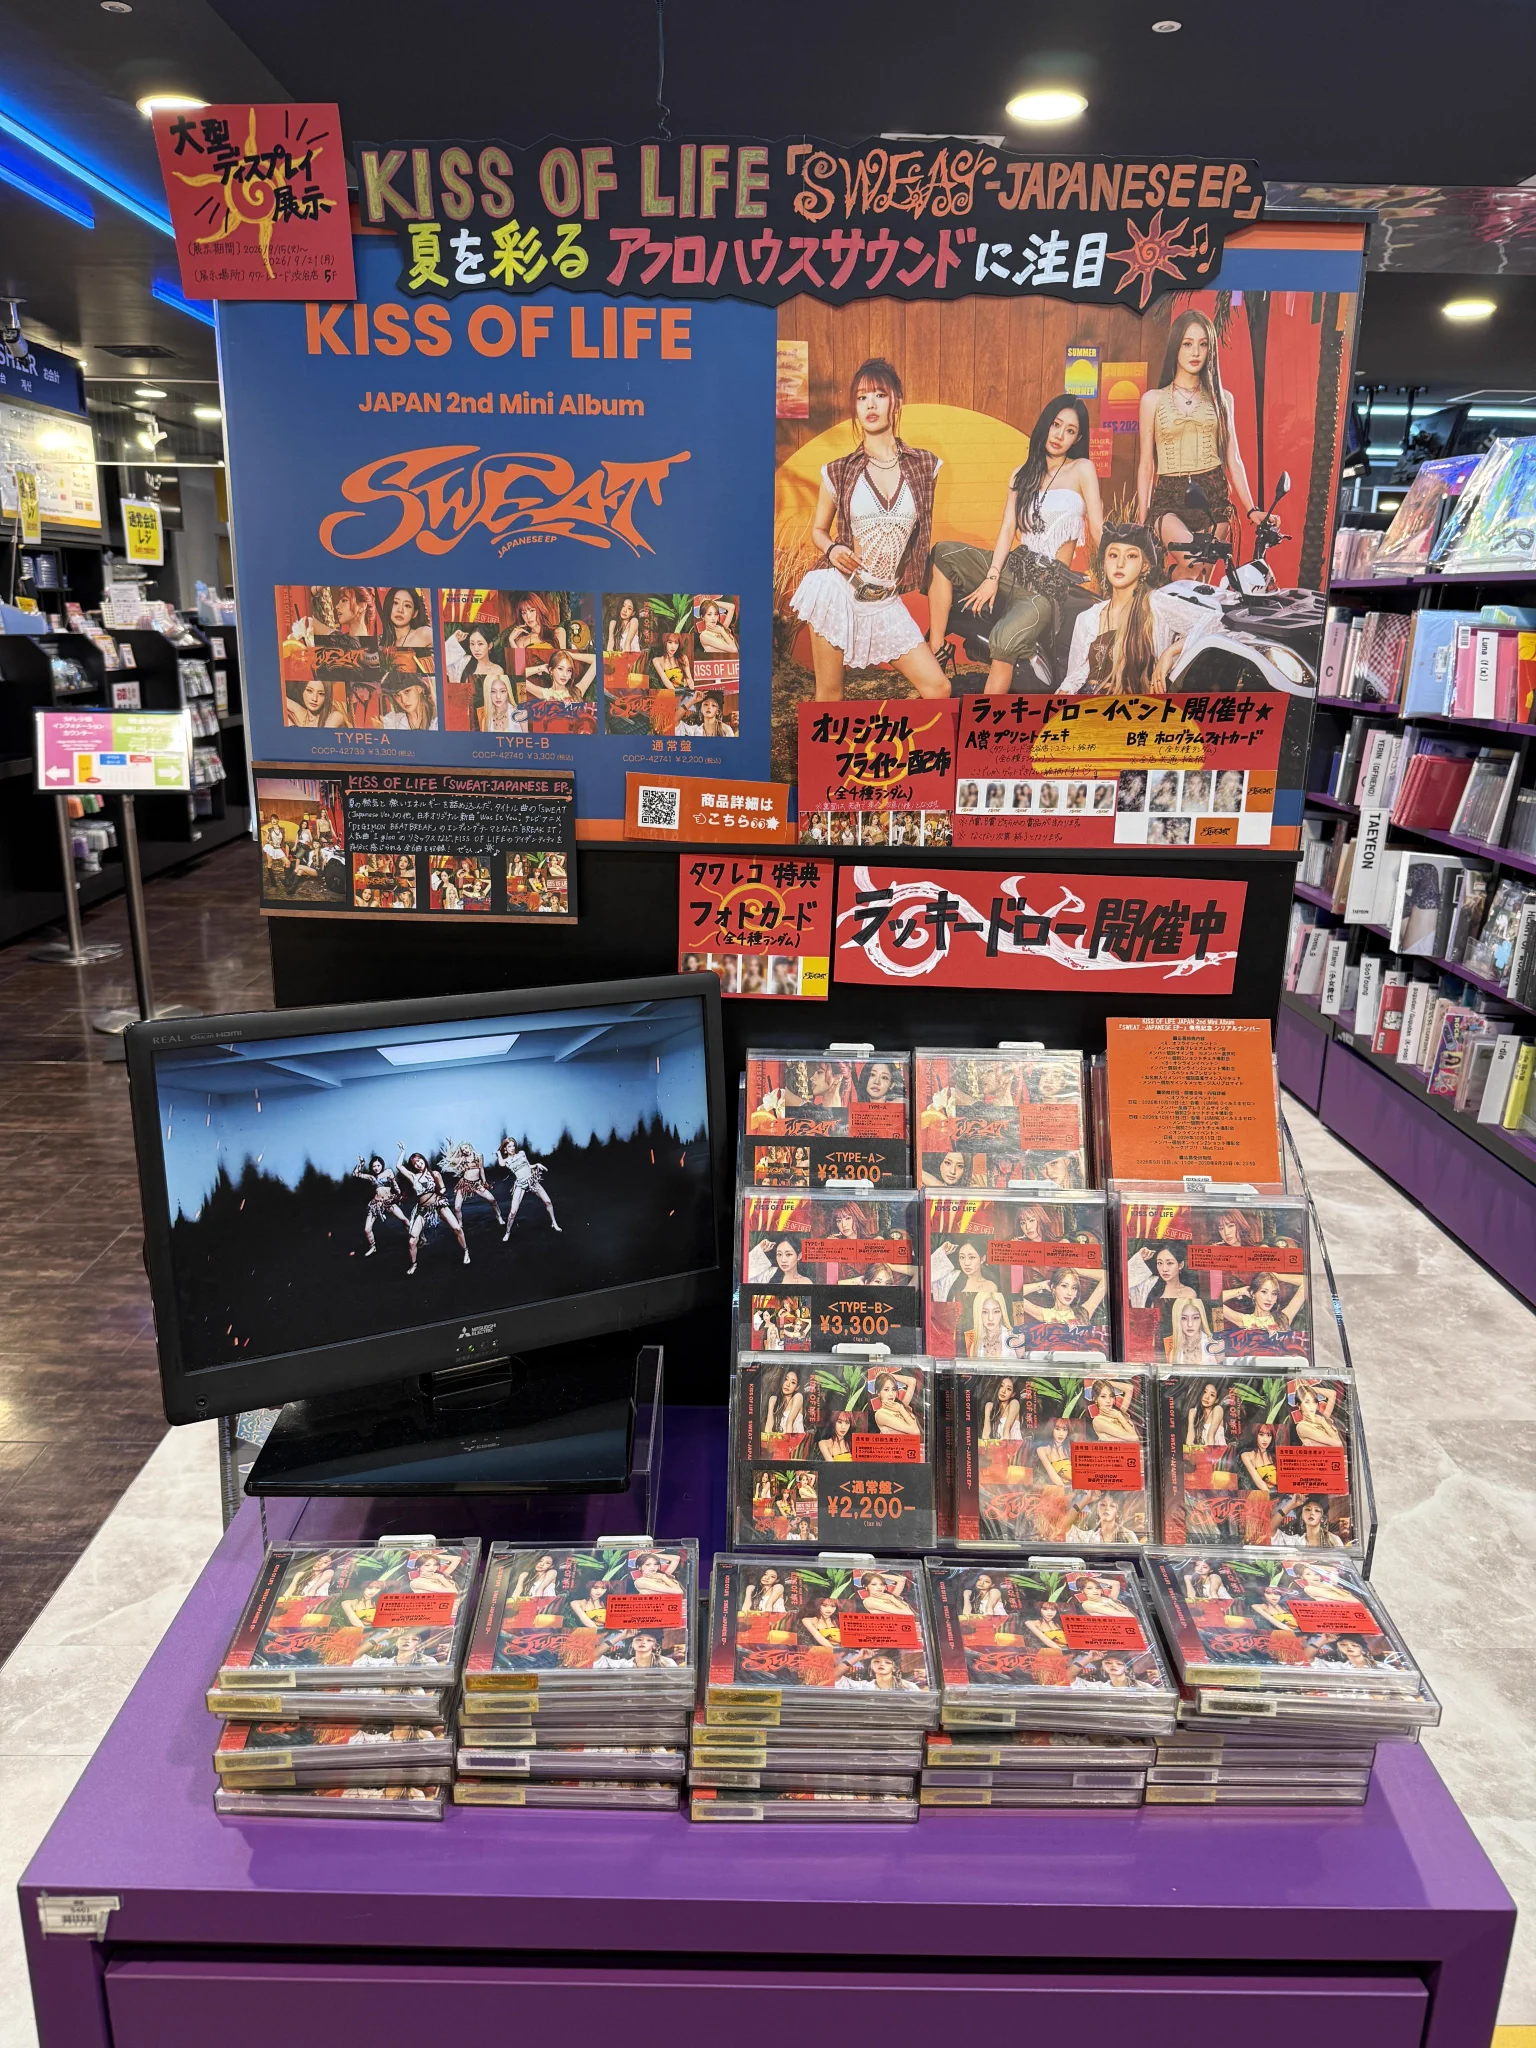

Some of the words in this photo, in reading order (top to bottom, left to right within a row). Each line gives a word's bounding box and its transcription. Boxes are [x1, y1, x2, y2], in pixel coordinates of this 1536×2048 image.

[169, 116, 230, 156] 大型
[213, 145, 314, 187] ディスプレイ
[361, 146, 515, 223] KISS
[539, 146, 618, 221] OF
[640, 143, 771, 220] LIFE
[271, 185, 332, 224] 展示
[408, 219, 589, 290] 夏を彩る
[323, 268, 339, 284] 5F
[306, 303, 453, 357] KISS
[467, 305, 555, 359] OF
[571, 307, 693, 362] LIFE
[1067, 347, 1097, 358] SUMMER
[358, 392, 441, 414] JAPAN
[446, 393, 494, 415] 2nd
[500, 394, 553, 416] Mini
[557, 395, 646, 418] Album
[1119, 421, 1140, 432] 202
[318, 445, 692, 560] SWEAT
[497, 536, 544, 559] JAPANESE
[545, 535, 559, 545] EP
[1481, 637, 1490, 656] Luna
[714, 665, 725, 676] OF
[334, 732, 391, 745] TYPE-A
[811, 713, 914, 745] オリジナル
[1126, 730, 1149, 747] B賞
[1154, 729, 1264, 746] ホログラムフォトカード
[311, 746, 365, 756] COCP-42739
[495, 736, 550, 749] TYPE-B
[652, 739, 692, 752] 通常盤
[1376, 739, 1387, 761] YERIN
[472, 751, 524, 760] COCP-42740
[622, 754, 672, 763] COCP-42741
[836, 747, 951, 779] フライヤー配布
[349, 775, 379, 790] KISS
[383, 776, 402, 790] OF
[405, 777, 438, 791] LIFE
[1367, 762, 1381, 797] (GFRIEND)
[700, 793, 774, 811] 商品詳細は
[826, 785, 913, 803] (全4種ランダム)
[708, 814, 750, 828] こちら
[1362, 812, 1382, 871] TAEYEON
[689, 862, 763, 886] タワレコ
[771, 861, 821, 888] 特典
[689, 900, 818, 931] フォトカード
[854, 888, 1228, 962] ラッキードロー開催中
[715, 930, 801, 949] (全4種ランダム)
[1328, 946, 1340, 969] Tiffany
[1361, 963, 1373, 997] SooYoung
[152, 1035, 183, 1045] REAL
[770, 1204, 780, 1212] OF
[863, 1520, 875, 1528] (tax
